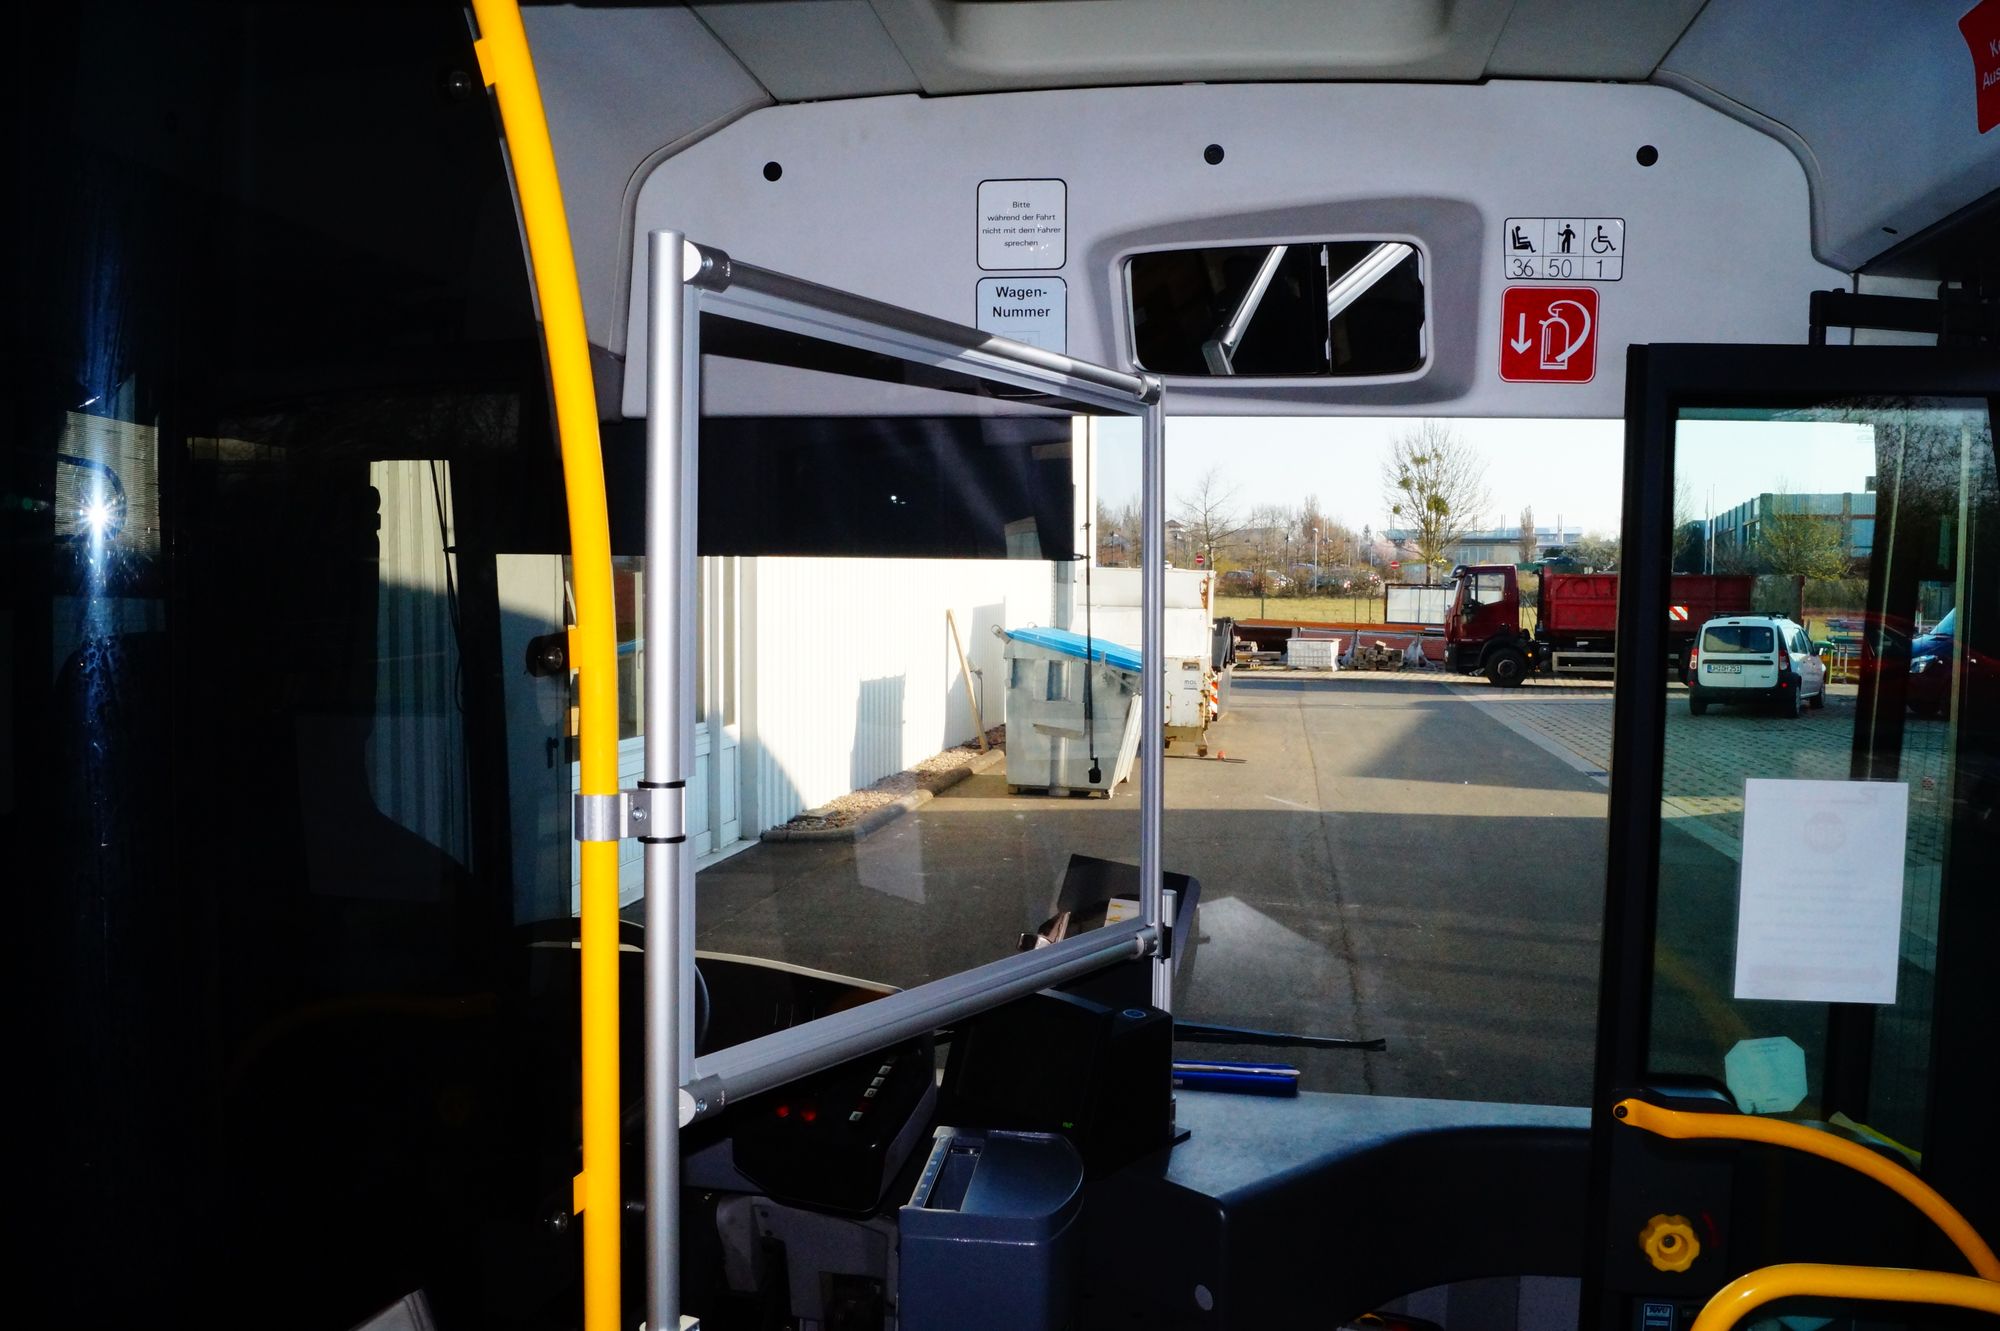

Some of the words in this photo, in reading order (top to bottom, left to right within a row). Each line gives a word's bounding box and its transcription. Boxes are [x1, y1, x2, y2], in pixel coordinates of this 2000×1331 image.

[1989, 38, 2000, 57] K
[1012, 201, 1031, 209] Bitte
[1036, 213, 1056, 221] Fahrt
[1037, 226, 1061, 234] Fahrer
[1513, 258, 1534, 278] 36
[1548, 258, 1573, 278] 50
[1596, 259, 1603, 278] 1
[995, 286, 1048, 300] Wagen-
[992, 306, 1051, 318] Nummer
